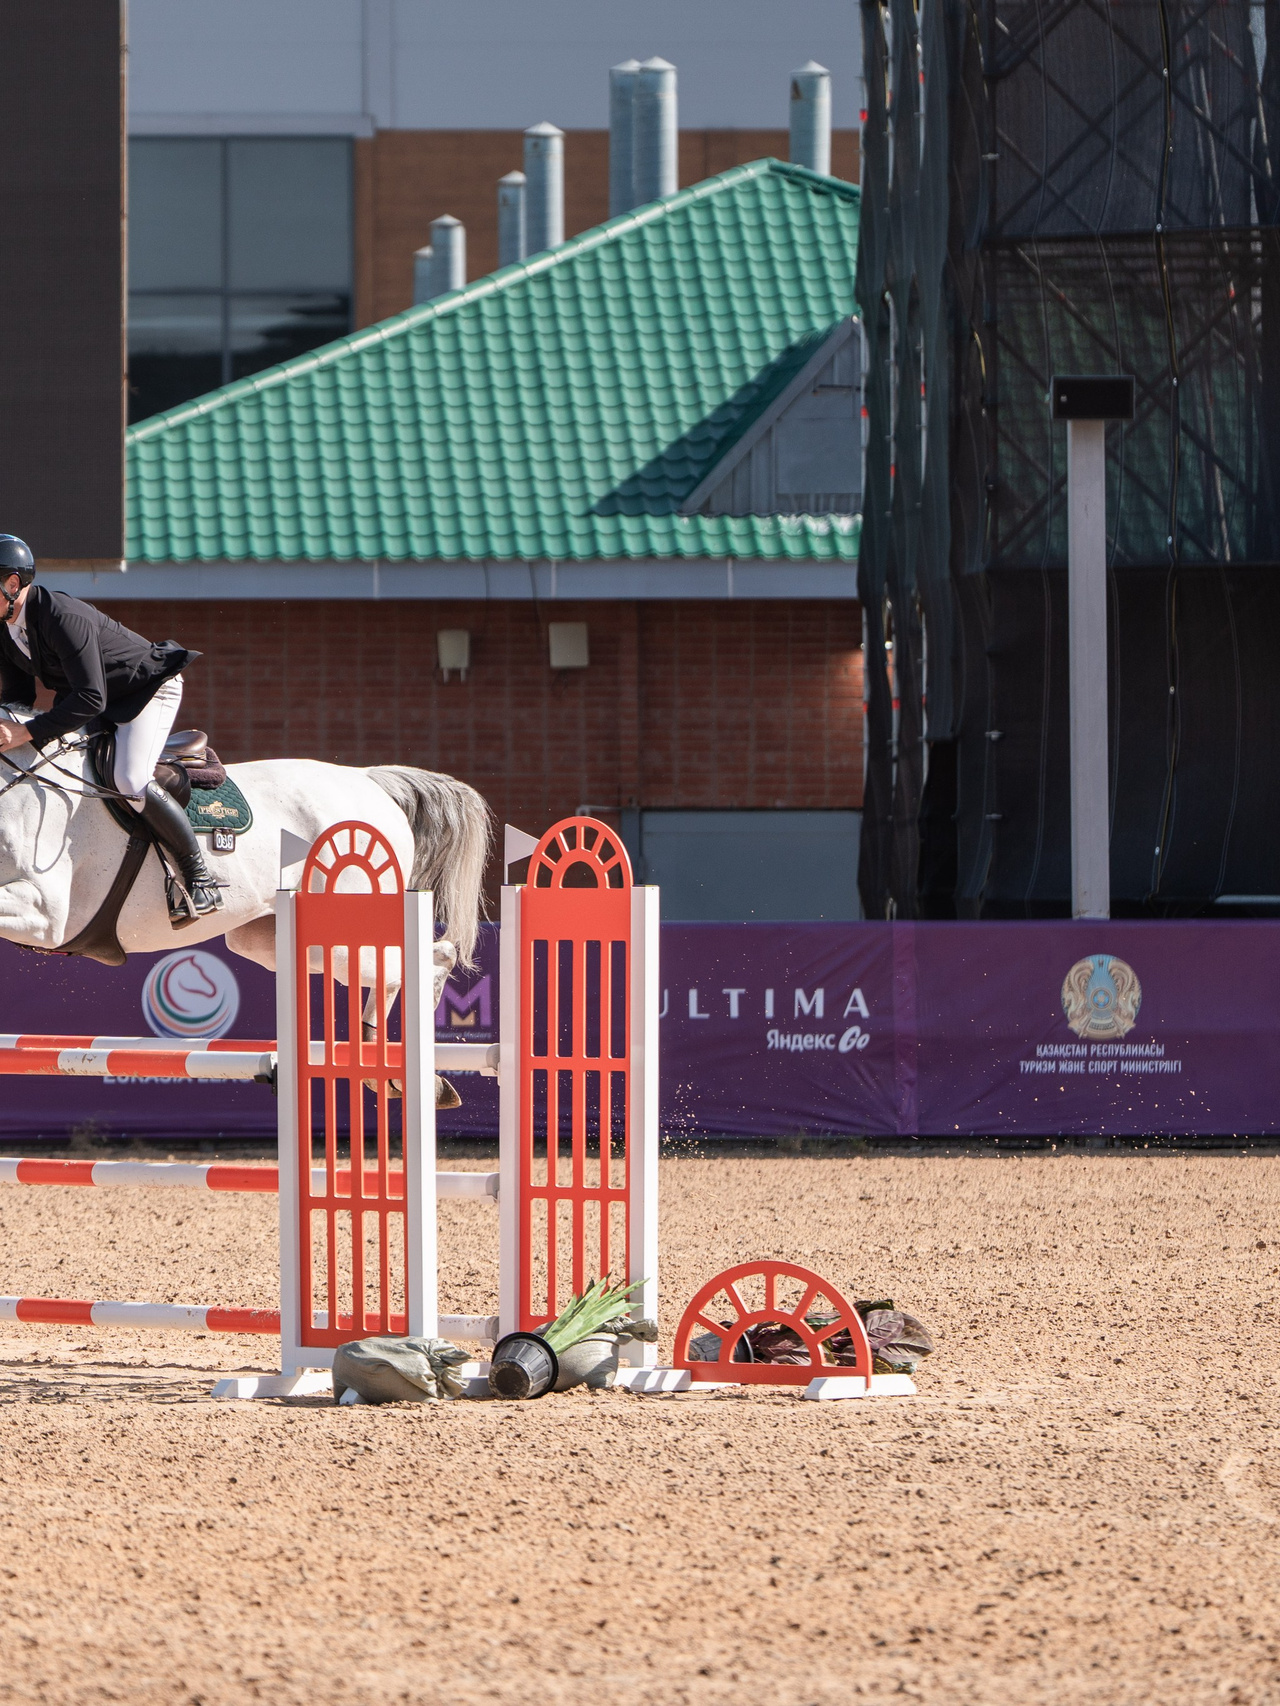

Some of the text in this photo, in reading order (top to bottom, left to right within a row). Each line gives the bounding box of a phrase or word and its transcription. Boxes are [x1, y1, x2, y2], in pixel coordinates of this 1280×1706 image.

[766, 1026, 870, 1053] Яндекс Go
[1091, 1044, 1164, 1057] РЕСПУБЛИКАСЫ
[1019, 1060, 1055, 1074] ТУРИЗМ
[1088, 1060, 1117, 1074] СПОРТ
